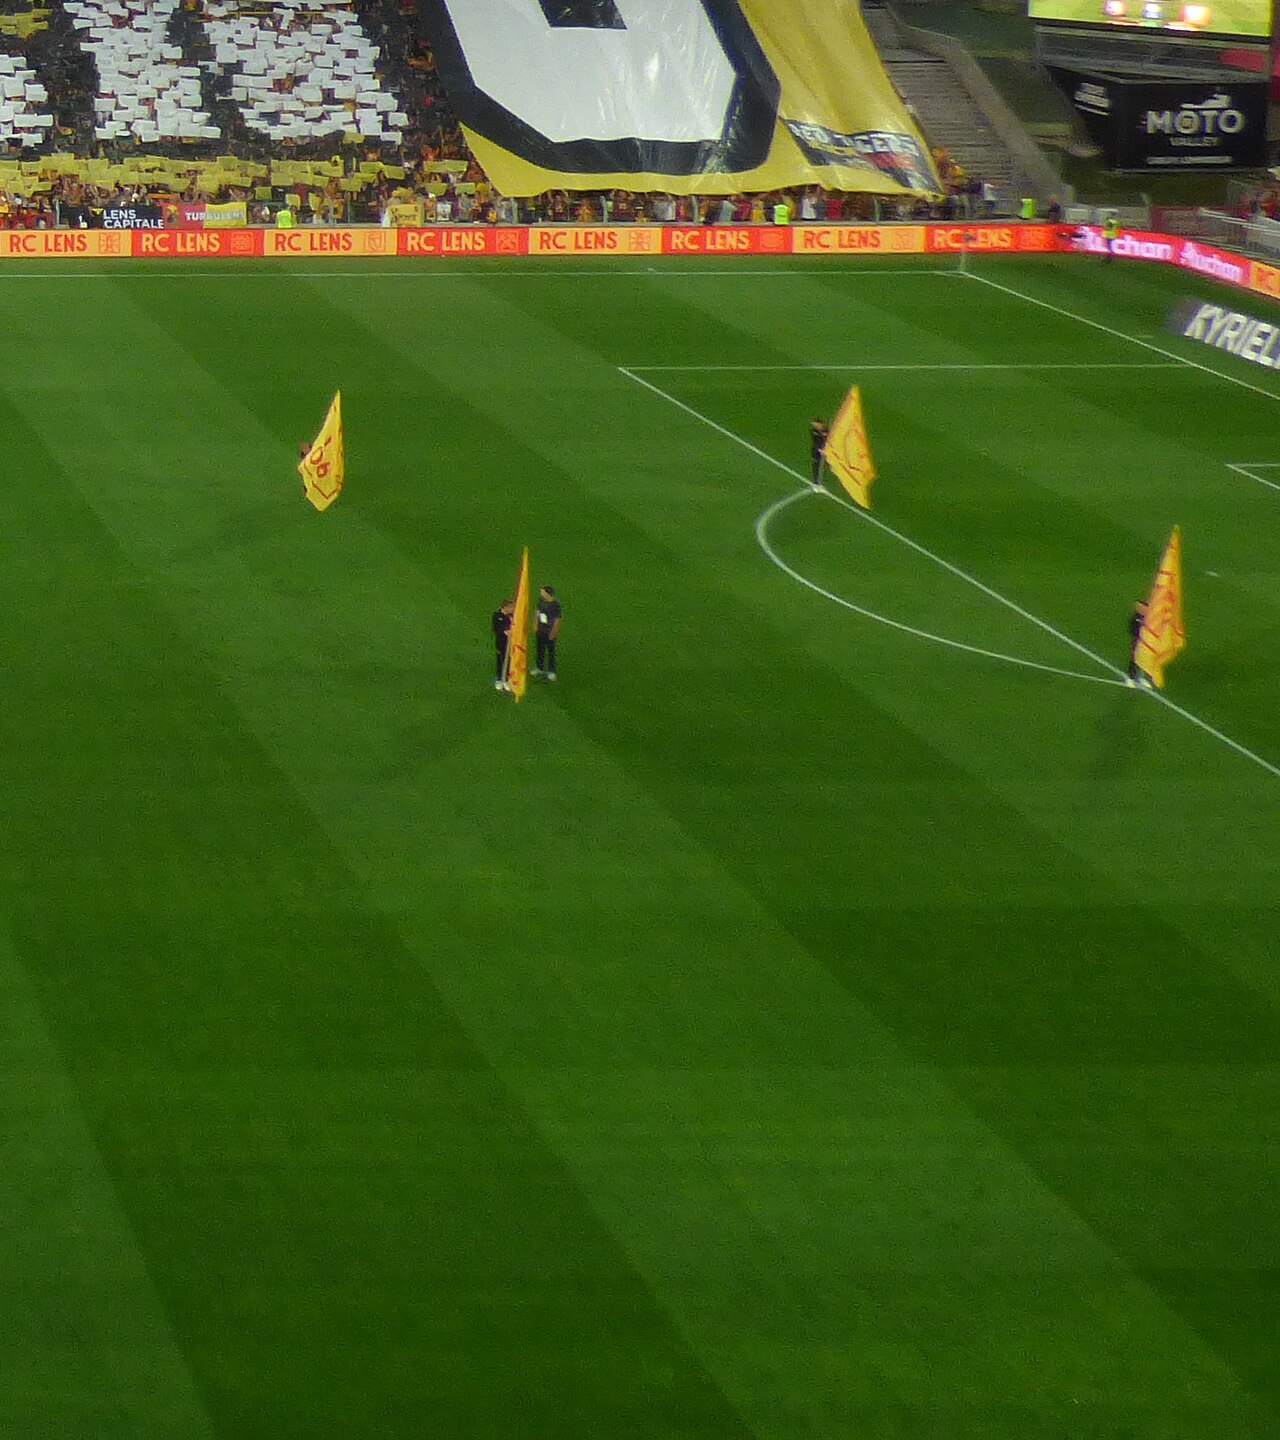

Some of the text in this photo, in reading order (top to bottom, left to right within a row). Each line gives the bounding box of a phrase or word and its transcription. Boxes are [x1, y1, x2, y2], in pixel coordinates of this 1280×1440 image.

[1146, 109, 1245, 134] MOTO
[103, 210, 137, 220] LENS
[103, 219, 165, 229] CAPITALE
[10, 234, 88, 252] RC LENS
[142, 232, 220, 252] RC LENS
[274, 232, 353, 252] RC LENS
[407, 232, 486, 251] RC LENS
[539, 231, 618, 250] RC LENS
[671, 230, 750, 250] RC LENS
[804, 230, 882, 250] RC LENS
[933, 228, 1012, 248] RC LENS
[1180, 242, 1242, 282] Auchan
[1183, 303, 1280, 371] KYRIEL
